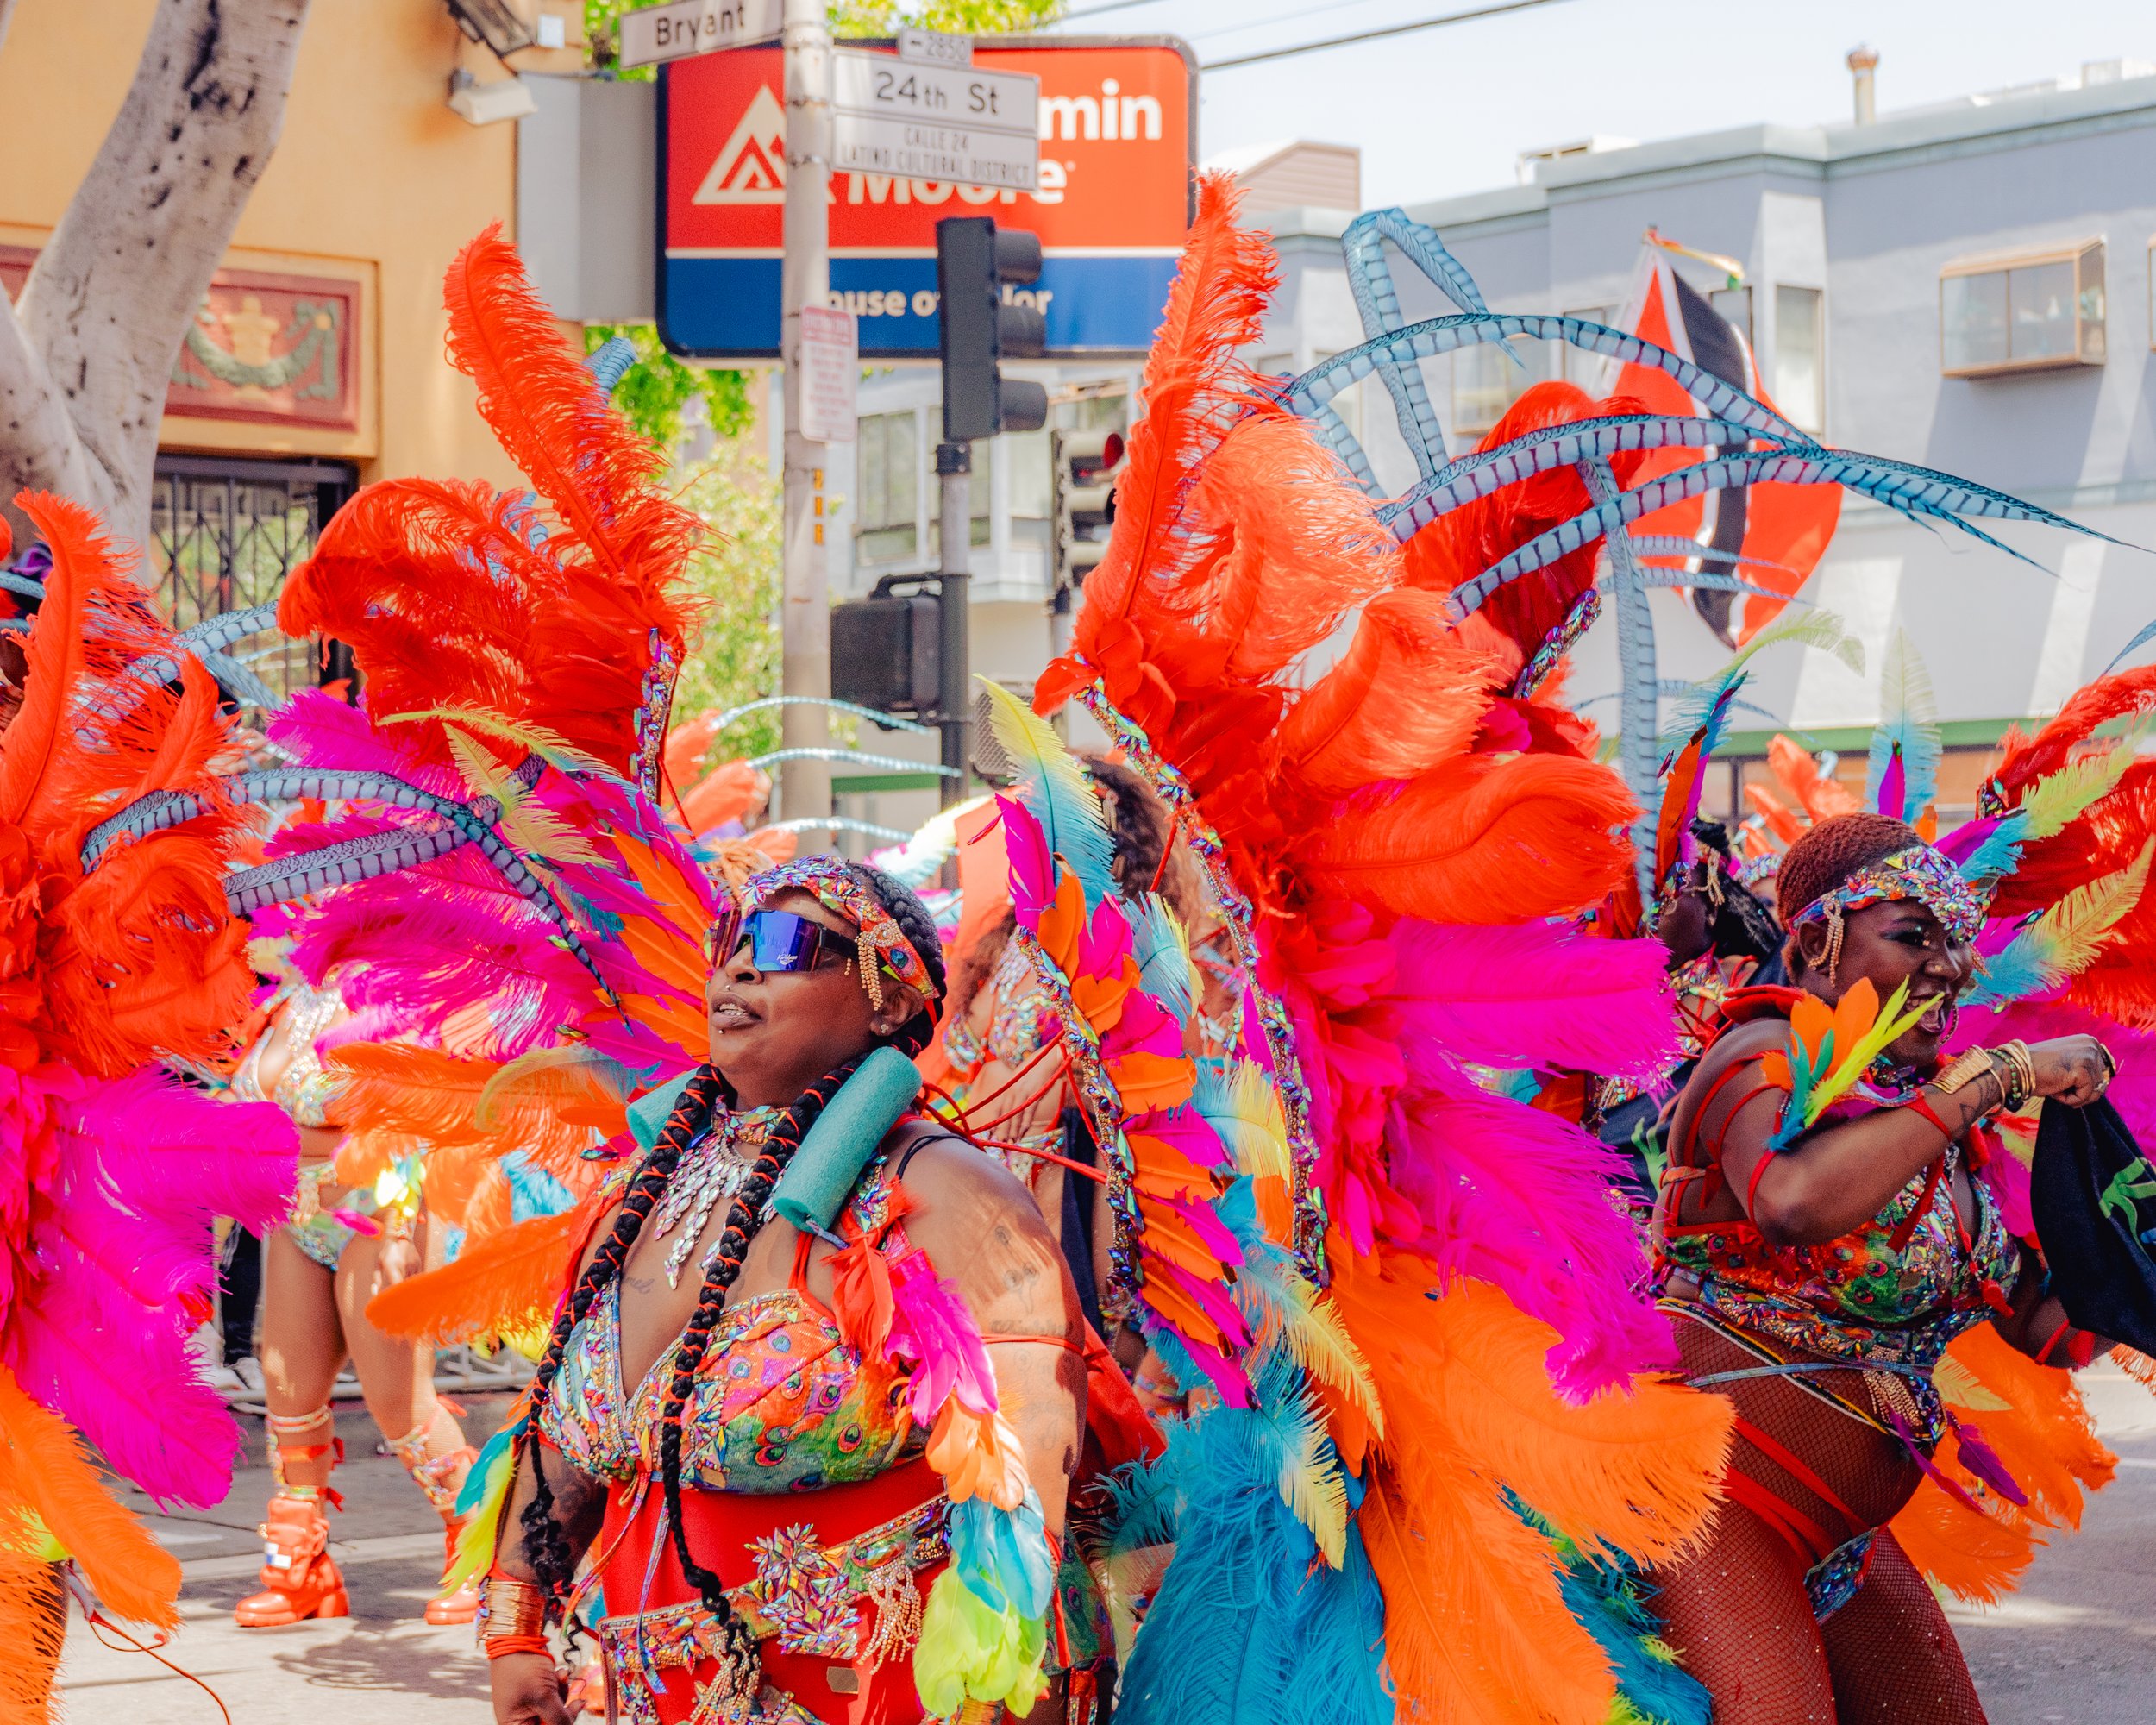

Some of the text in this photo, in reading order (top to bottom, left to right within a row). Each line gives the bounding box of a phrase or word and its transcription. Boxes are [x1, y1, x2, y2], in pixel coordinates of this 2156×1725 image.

[656, 3, 744, 49] Bryant
[926, 34, 969, 61] 2850
[875, 71, 999, 115] 24th St
[1038, 78, 1163, 141] min
[905, 127, 969, 153] CALLE 24
[842, 142, 1030, 185] LATINO CULTURAL DISTRICT
[828, 283, 1054, 317] ouse o lor
